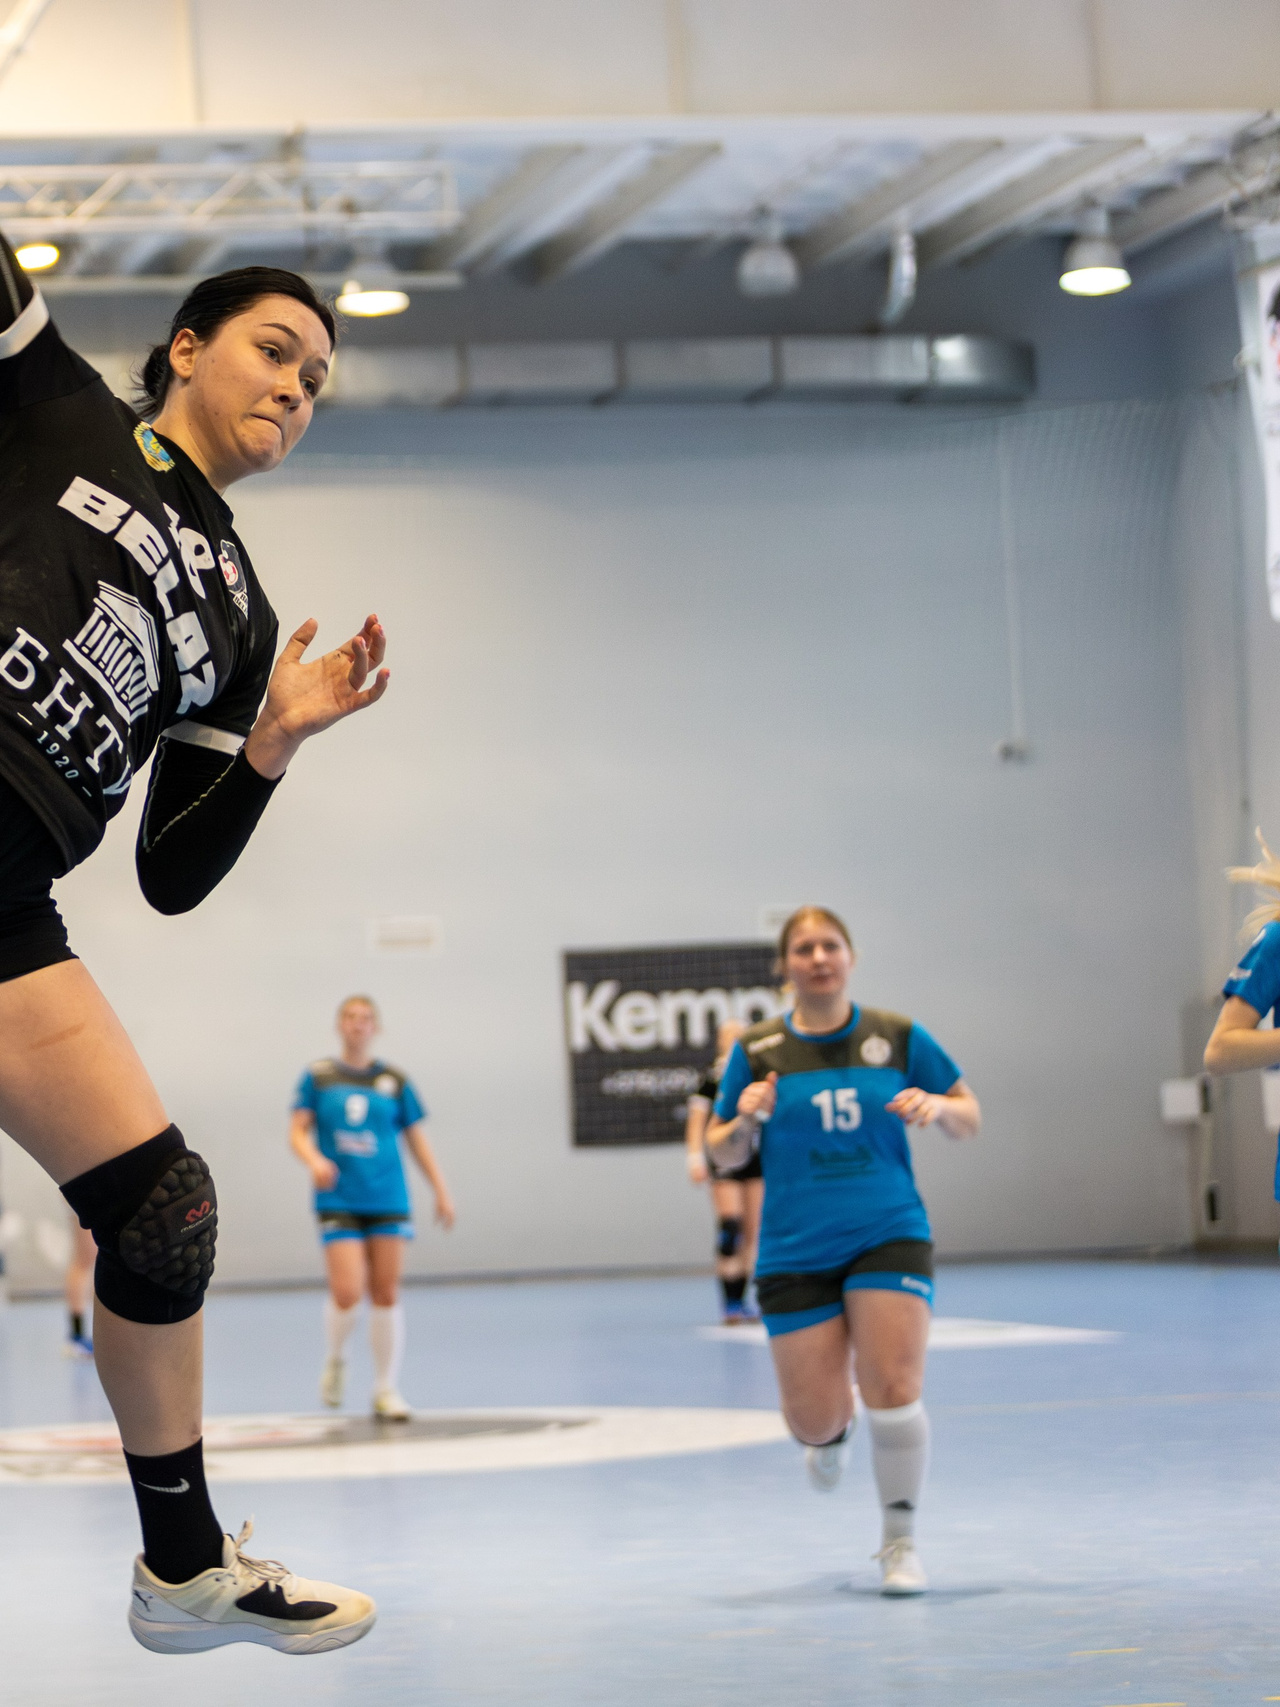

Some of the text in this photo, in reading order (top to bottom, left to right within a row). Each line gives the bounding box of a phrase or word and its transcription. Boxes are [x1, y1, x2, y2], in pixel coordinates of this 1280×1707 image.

[36, 730, 80, 779] 1920
[568, 979, 796, 1052] Kemp
[811, 1087, 862, 1132] 15
